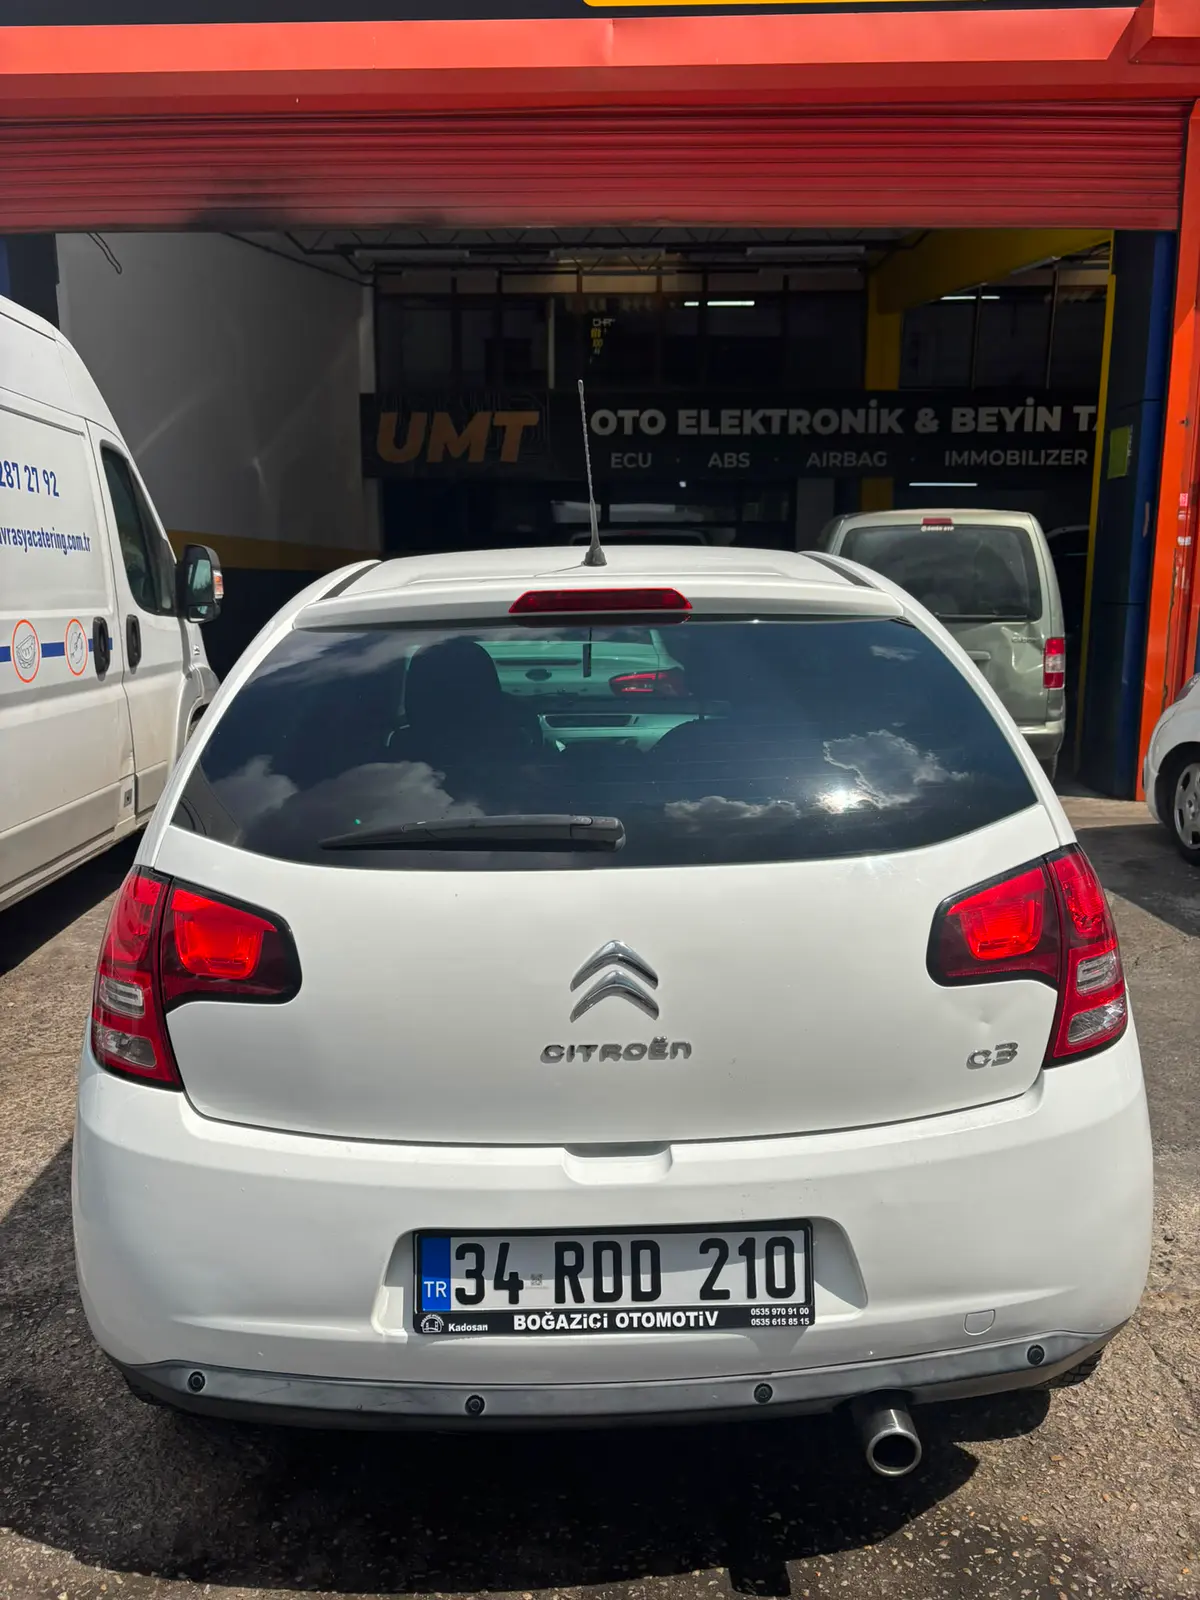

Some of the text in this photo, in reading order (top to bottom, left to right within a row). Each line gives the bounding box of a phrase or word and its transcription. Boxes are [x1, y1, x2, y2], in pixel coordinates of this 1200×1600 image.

[590, 396, 1098, 436] OTO ELEKTRONİK & BEYİN T
[376, 412, 539, 463] UMT
[610, 452, 652, 469] ECU
[707, 452, 751, 469] ABS
[806, 450, 888, 468] AIRBAG
[944, 448, 1089, 467] IMMOBILIZER
[24, 465, 40, 493] 27
[42, 469, 60, 497] 92
[0, 526, 91, 555] vrasyacatering.com.tr
[966, 1042, 1018, 1070] C3
[455, 1236, 796, 1305] 34 RDD 210
[424, 1281, 447, 1298] TR
[750, 1307, 810, 1316] 0535 970 91 00
[448, 1323, 488, 1332] Kadosan
[750, 1317, 810, 1326] 0535 615 85 15
